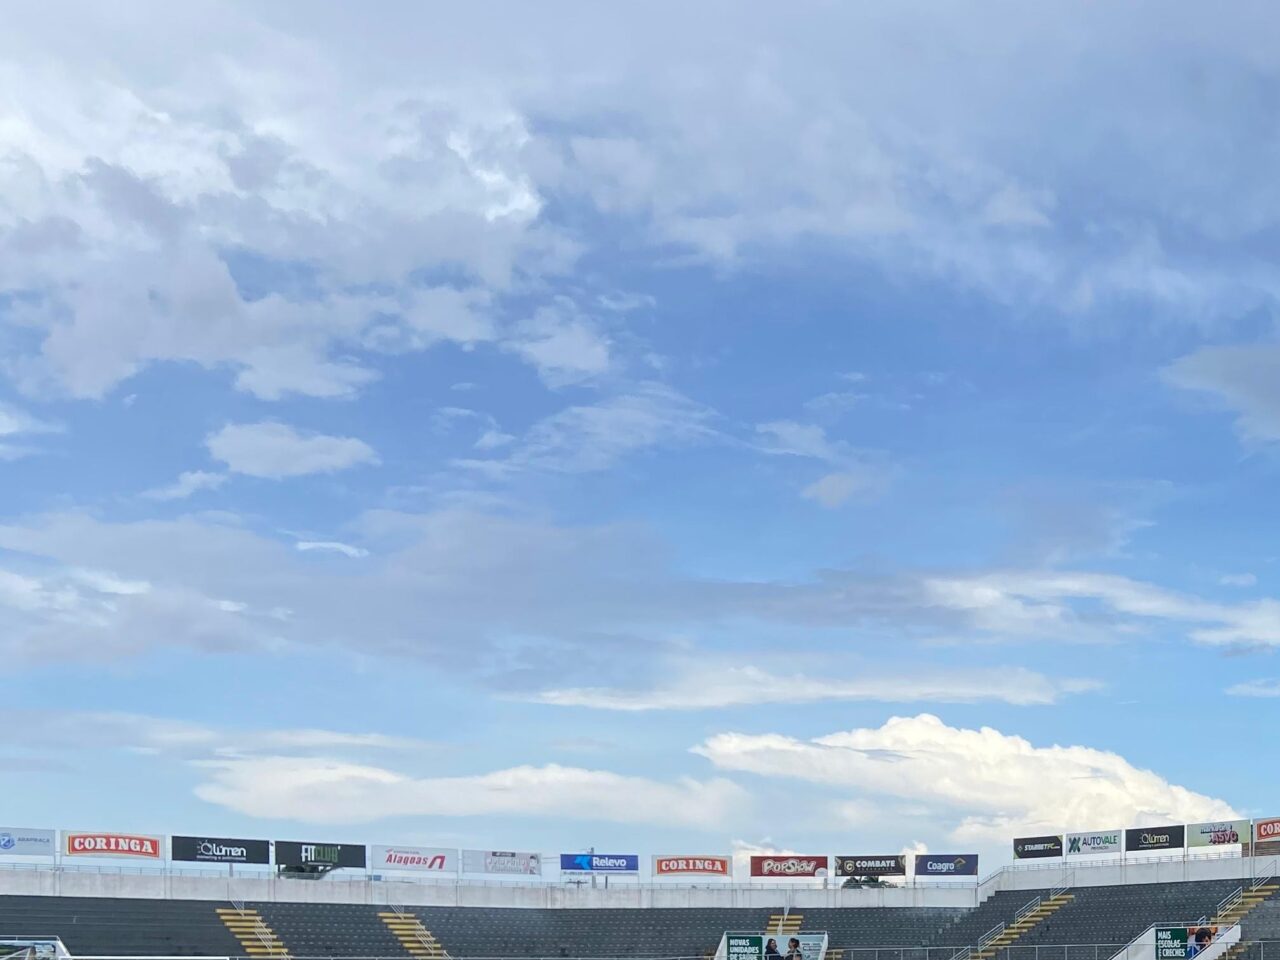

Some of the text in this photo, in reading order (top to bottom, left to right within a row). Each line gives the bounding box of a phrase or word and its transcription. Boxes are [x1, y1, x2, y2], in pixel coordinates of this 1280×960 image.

[73, 837, 154, 854] CORINGA
[1082, 835, 1118, 847] AUTOVALE
[385, 854, 429, 865] Alagoas
[592, 857, 626, 868] Relevo
[856, 860, 896, 868] COMBATE
[661, 860, 723, 871] CORINGA
[927, 861, 955, 872] Coagro
[1158, 931, 1171, 939] MAIS
[730, 938, 750, 946] NOVAS
[1158, 939, 1181, 948] ESCOLAS
[730, 946, 759, 954] UNIDADES
[1163, 948, 1186, 957] CRECHES
